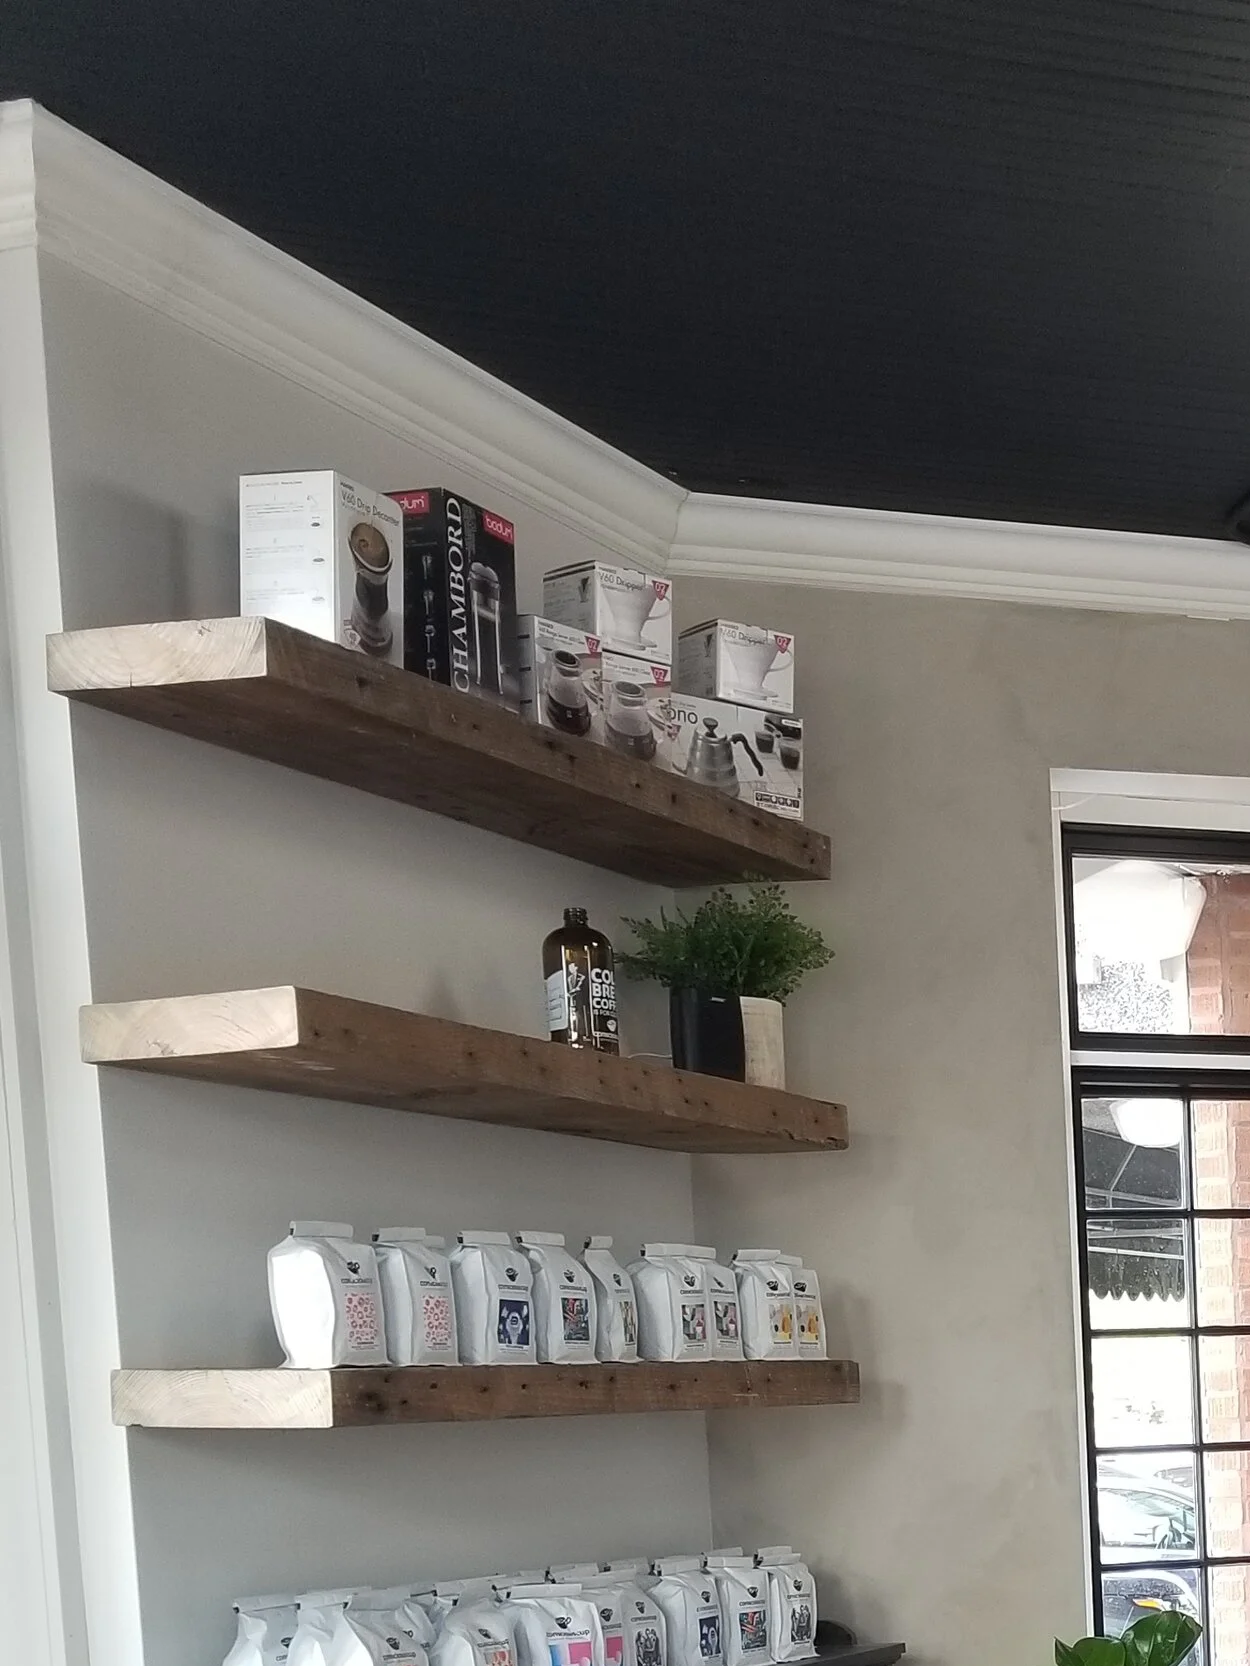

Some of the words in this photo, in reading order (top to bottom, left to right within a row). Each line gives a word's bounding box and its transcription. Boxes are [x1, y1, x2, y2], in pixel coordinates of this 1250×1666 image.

[485, 514, 513, 540] bodum
[446, 498, 470, 693] CHAMBORD
[591, 967, 615, 985] COL
[592, 982, 616, 999] BRE
[592, 997, 617, 1010] COFF
